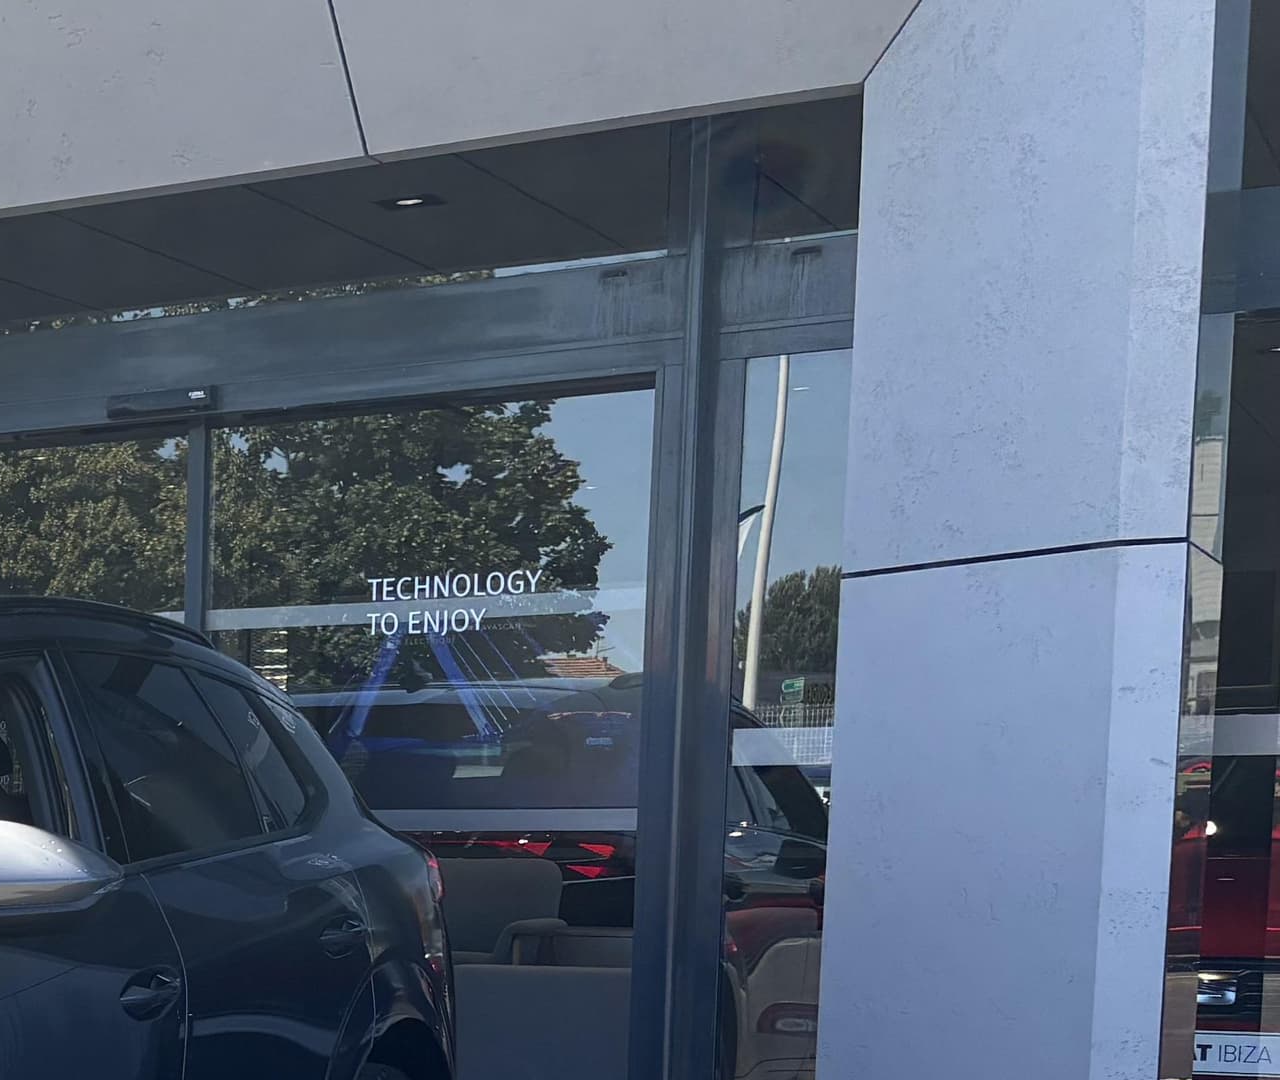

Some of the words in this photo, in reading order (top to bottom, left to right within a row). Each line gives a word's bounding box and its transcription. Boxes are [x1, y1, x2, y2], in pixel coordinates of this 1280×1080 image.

[367, 569, 543, 601] TECHNOLOGY
[366, 612, 398, 636] TO
[408, 607, 487, 636] ENJOY
[1193, 1044, 1213, 1062] T
[1218, 1044, 1272, 1064] IBIZA
